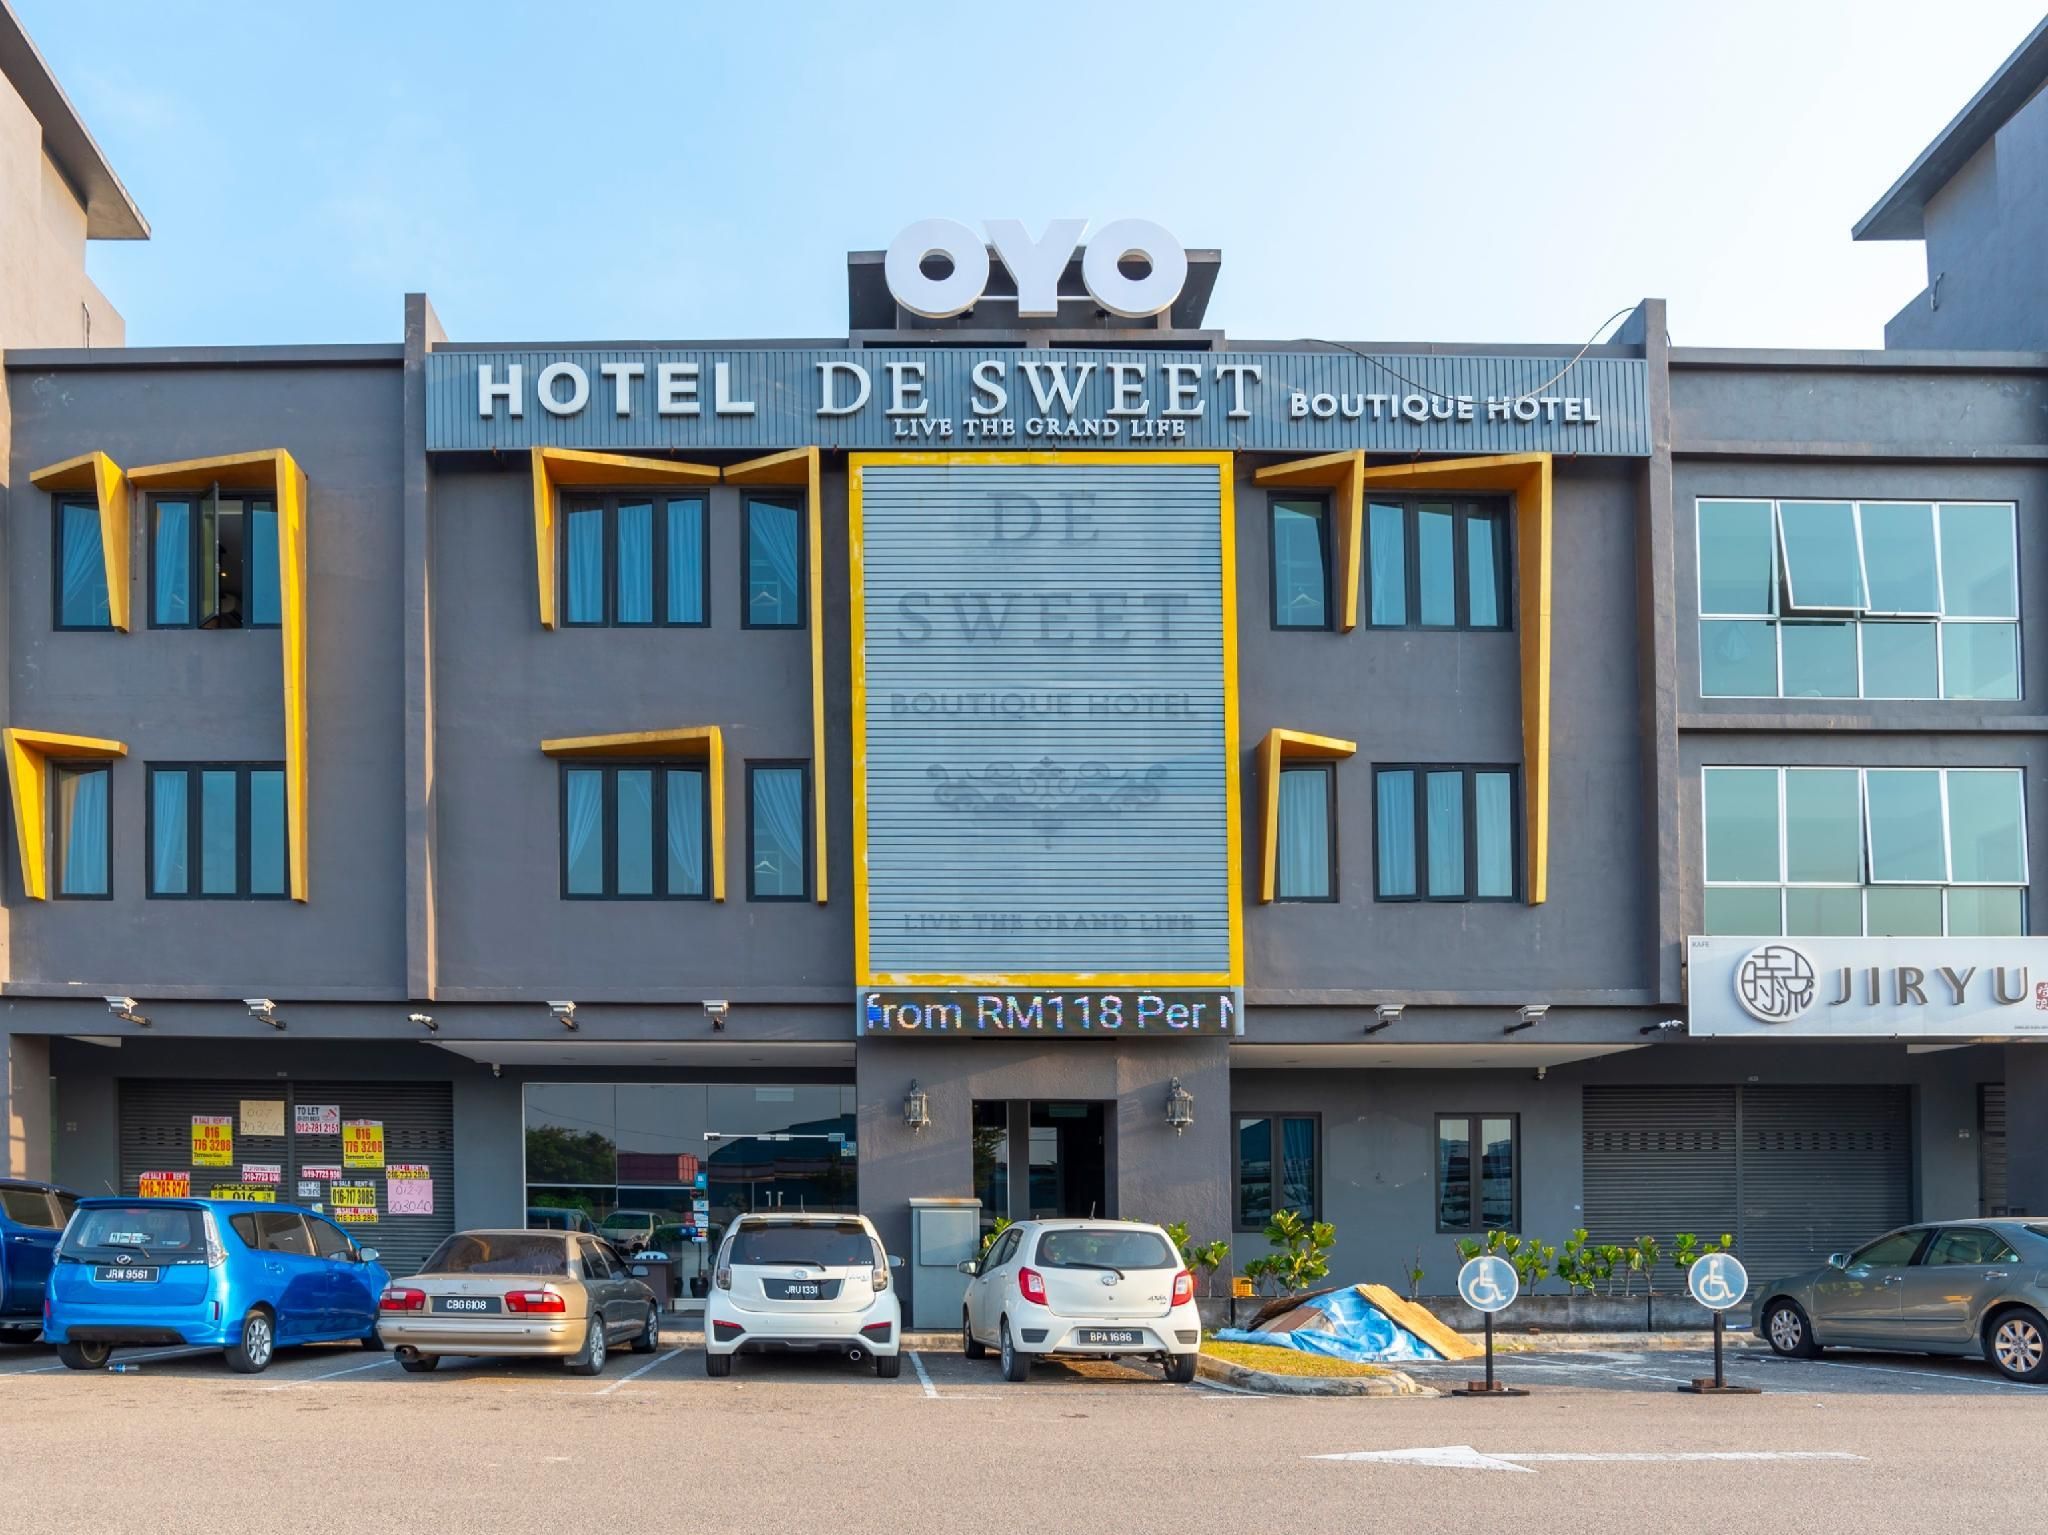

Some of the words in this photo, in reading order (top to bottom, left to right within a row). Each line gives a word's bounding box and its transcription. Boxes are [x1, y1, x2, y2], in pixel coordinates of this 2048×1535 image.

[885, 217, 1188, 319] OYO
[478, 361, 756, 417] HOTEL
[816, 361, 929, 417] DE
[970, 360, 1263, 418] SWEET
[1290, 392, 1474, 424] BOUTIQUE
[1487, 396, 1600, 424] HOTEL
[894, 417, 953, 437] LIVE
[963, 418, 1016, 437] THE
[1025, 417, 1121, 438] GRAND
[1130, 418, 1187, 438] LIFE
[986, 490, 1101, 546] DE
[896, 590, 1188, 645] SWEET
[890, 692, 1073, 719] BOUTIQUE
[1088, 693, 1200, 718] HOTEL
[1826, 965, 2029, 1006] JIRYU
[866, 994, 962, 1030] from
[977, 995, 1123, 1030] RM118
[1137, 995, 1206, 1030] Per
[297, 1107, 306, 1115] TO
[307, 1107, 320, 1115] LET
[205, 1127, 219, 1138] 016
[356, 1128, 370, 1140] 016
[126, 1269, 148, 1279] 9561
[784, 1285, 802, 1295] JRU
[802, 1285, 818, 1295] 1331
[447, 1299, 465, 1310] CBG
[465, 1299, 487, 1310] 6108
[1090, 1331, 1108, 1342] BPA
